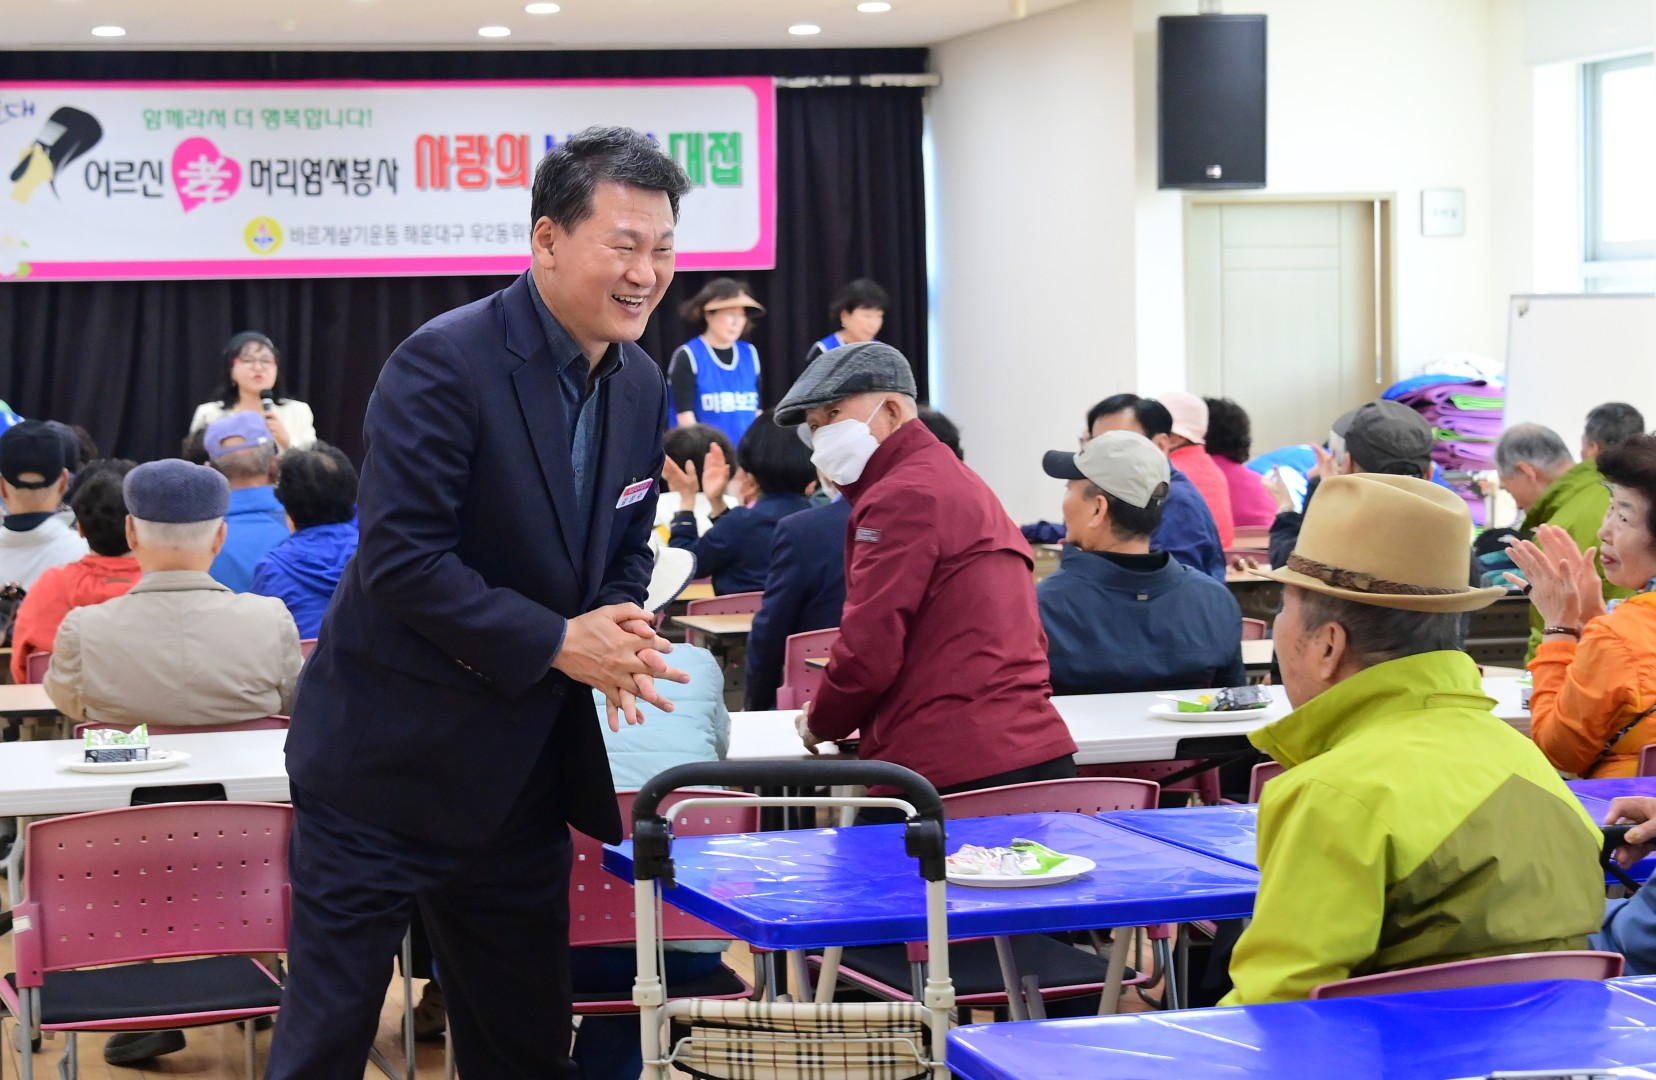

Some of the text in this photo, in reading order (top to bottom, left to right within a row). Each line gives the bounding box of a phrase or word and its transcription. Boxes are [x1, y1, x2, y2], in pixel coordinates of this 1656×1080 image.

[234, 108, 253, 129] 더
[260, 107, 374, 131] 행복합니다!
[84, 131, 743, 204] 어르신 孝 머리염색봉사 사랑의 대접
[290, 222, 532, 247] 바르게살기운동 해운대구 우2동위
